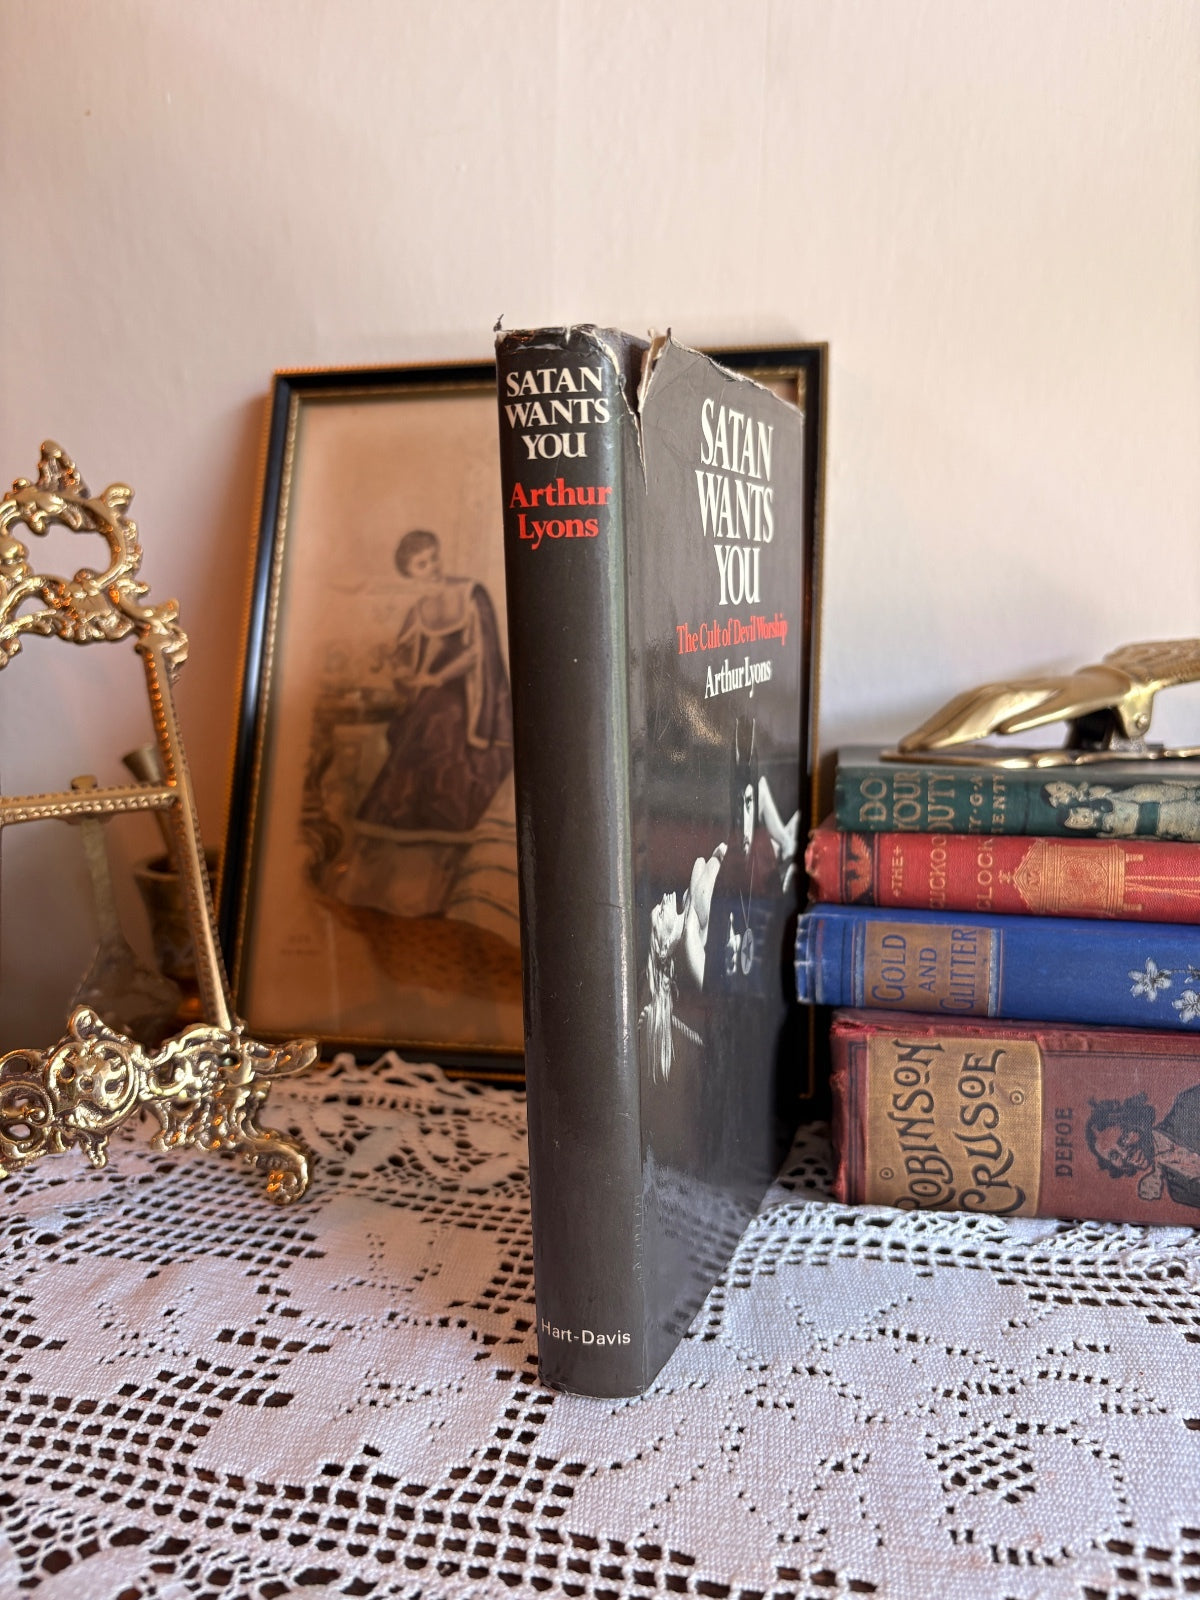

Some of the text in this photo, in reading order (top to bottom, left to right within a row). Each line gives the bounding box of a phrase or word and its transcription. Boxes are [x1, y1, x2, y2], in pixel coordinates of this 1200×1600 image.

[506, 366, 604, 397] SATAN
[504, 398, 611, 429] WANTS
[521, 432, 588, 460] YOU
[700, 397, 774, 482] SATAN
[509, 477, 613, 508] Arthur
[695, 470, 774, 543] WANTS
[517, 513, 599, 550] Lyons
[713, 544, 761, 605] YOU
[676, 613, 788, 655] The Cult of Devil Worship
[705, 656, 772, 699] Arthur Lyons
[872, 934, 907, 1003] GOLD
[918, 947, 937, 993] AND
[939, 928, 977, 1012] GLITTER
[888, 1038, 956, 1210] ROBINSON
[953, 1048, 1026, 1213] CRUSOE
[1055, 1107, 1073, 1178] DEFOE
[541, 1318, 631, 1345] Hart-Davis
